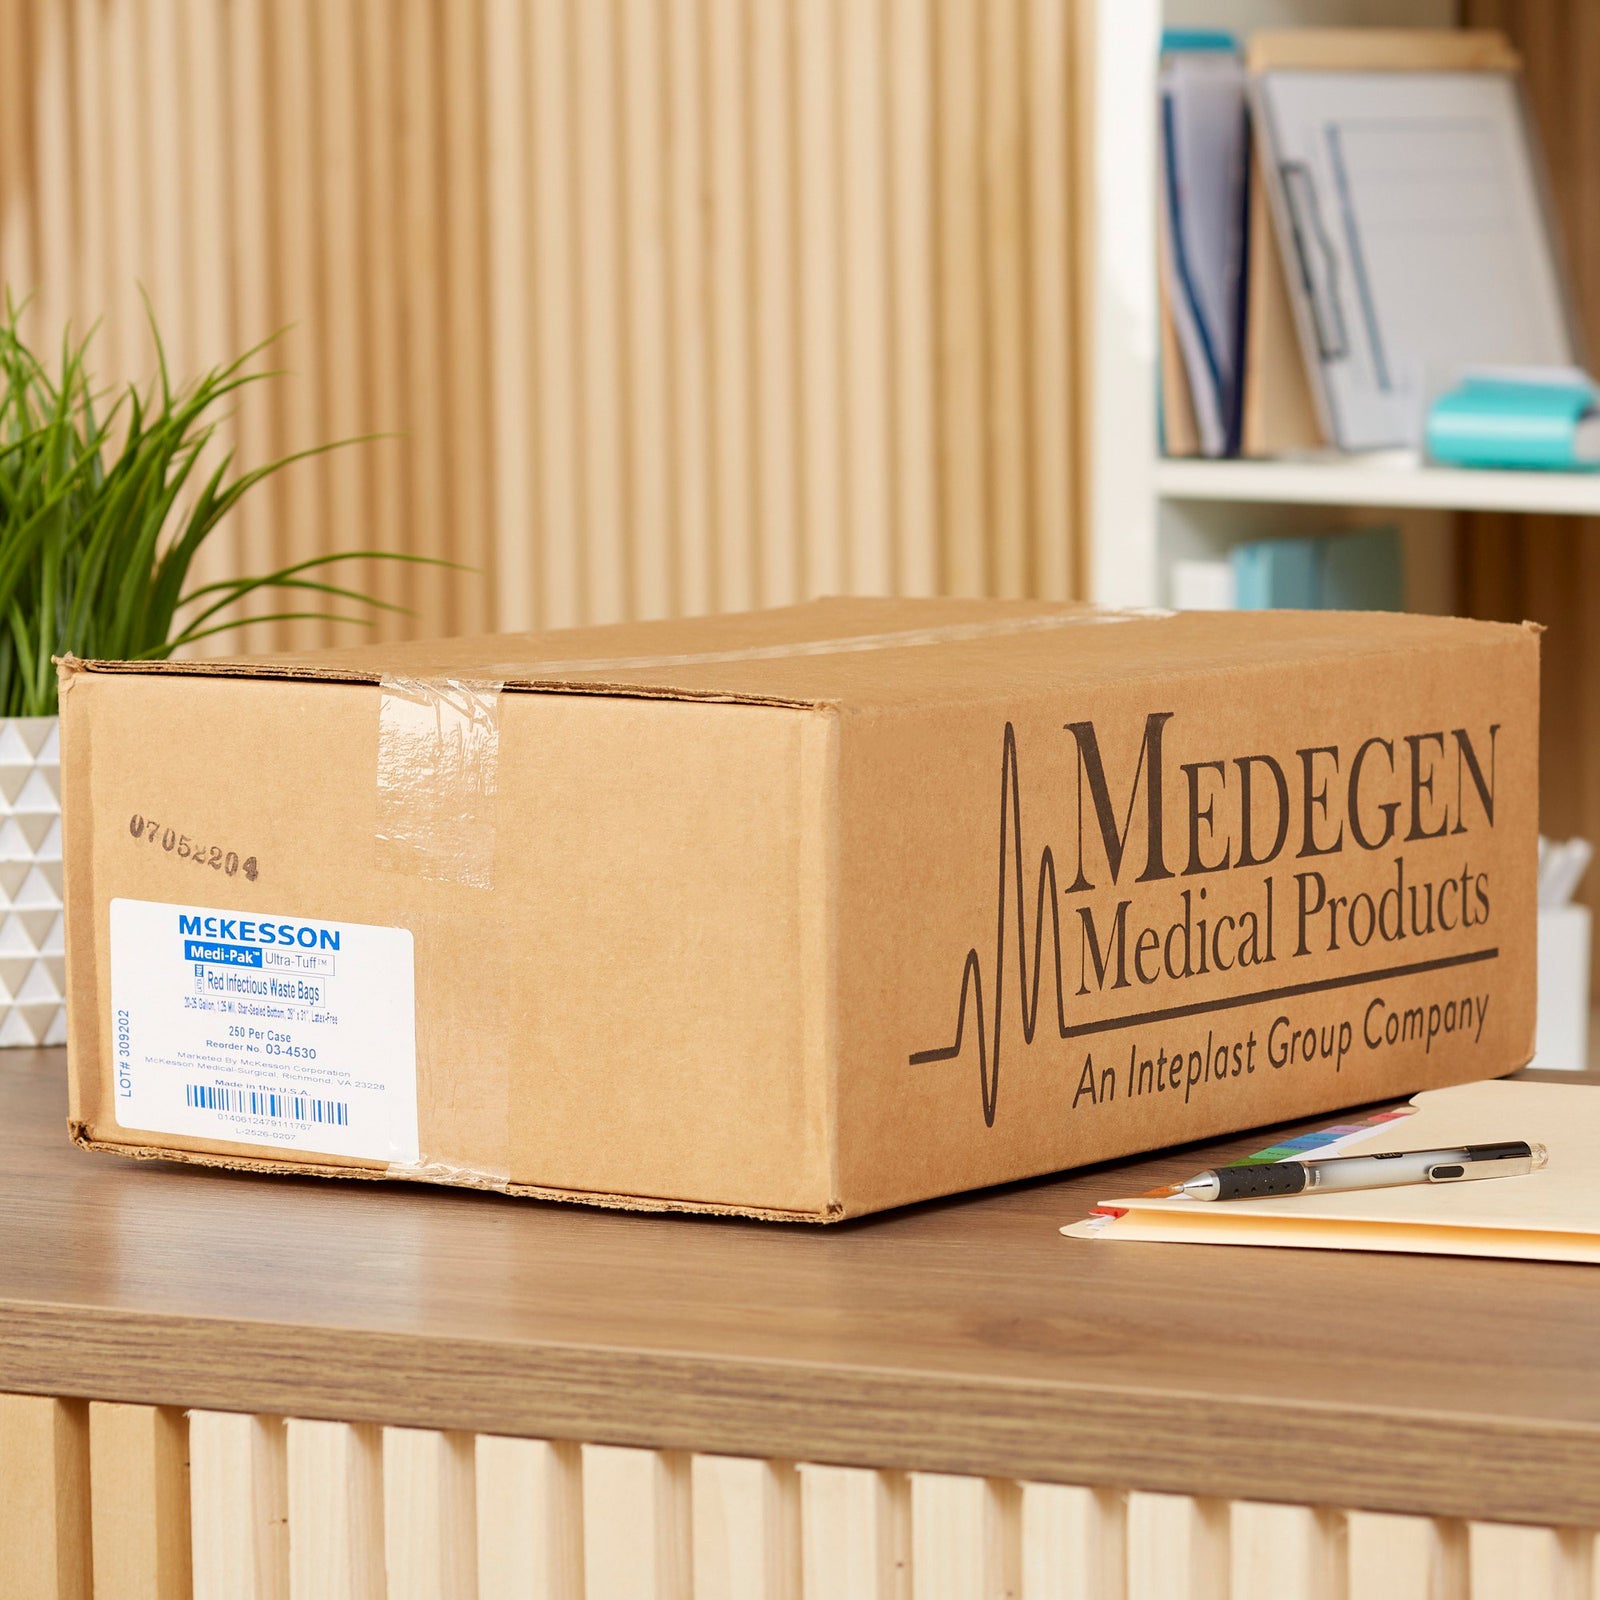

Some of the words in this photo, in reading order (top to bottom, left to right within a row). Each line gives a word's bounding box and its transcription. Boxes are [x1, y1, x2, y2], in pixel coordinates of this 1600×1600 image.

[1075, 877, 1277, 996] Medical
[1292, 856, 1491, 957] Products
[207, 970, 225, 992] Red
[226, 972, 268, 996] Infectious
[269, 976, 296, 1000] Waste
[297, 980, 320, 1006] Bags
[118, 1009, 131, 1057] 309202
[206, 1039, 244, 1052] Reorder
[246, 1044, 262, 1054] No.
[265, 1043, 317, 1060] 03-4530
[229, 1025, 246, 1038] 250
[248, 1027, 264, 1040] Per
[266, 1030, 292, 1043] Case
[177, 1051, 223, 1063] Marketed
[225, 1057, 238, 1065] By
[240, 1058, 291, 1071] McKesson
[293, 1065, 351, 1078] Corporation
[1072, 1053, 1117, 1109] An
[1127, 1031, 1256, 1104] Inteplast
[1266, 1016, 1353, 1073] Group
[1362, 994, 1490, 1053] Company
[119, 1063, 132, 1098] LOT#
[144, 1056, 194, 1068] McKesson
[282, 1072, 334, 1085] Richmond,
[336, 1079, 352, 1087] VA
[354, 1081, 386, 1091] 23228
[214, 1079, 243, 1088] Made
[259, 1084, 277, 1092] the
[279, 1086, 311, 1097] U.S.A.
